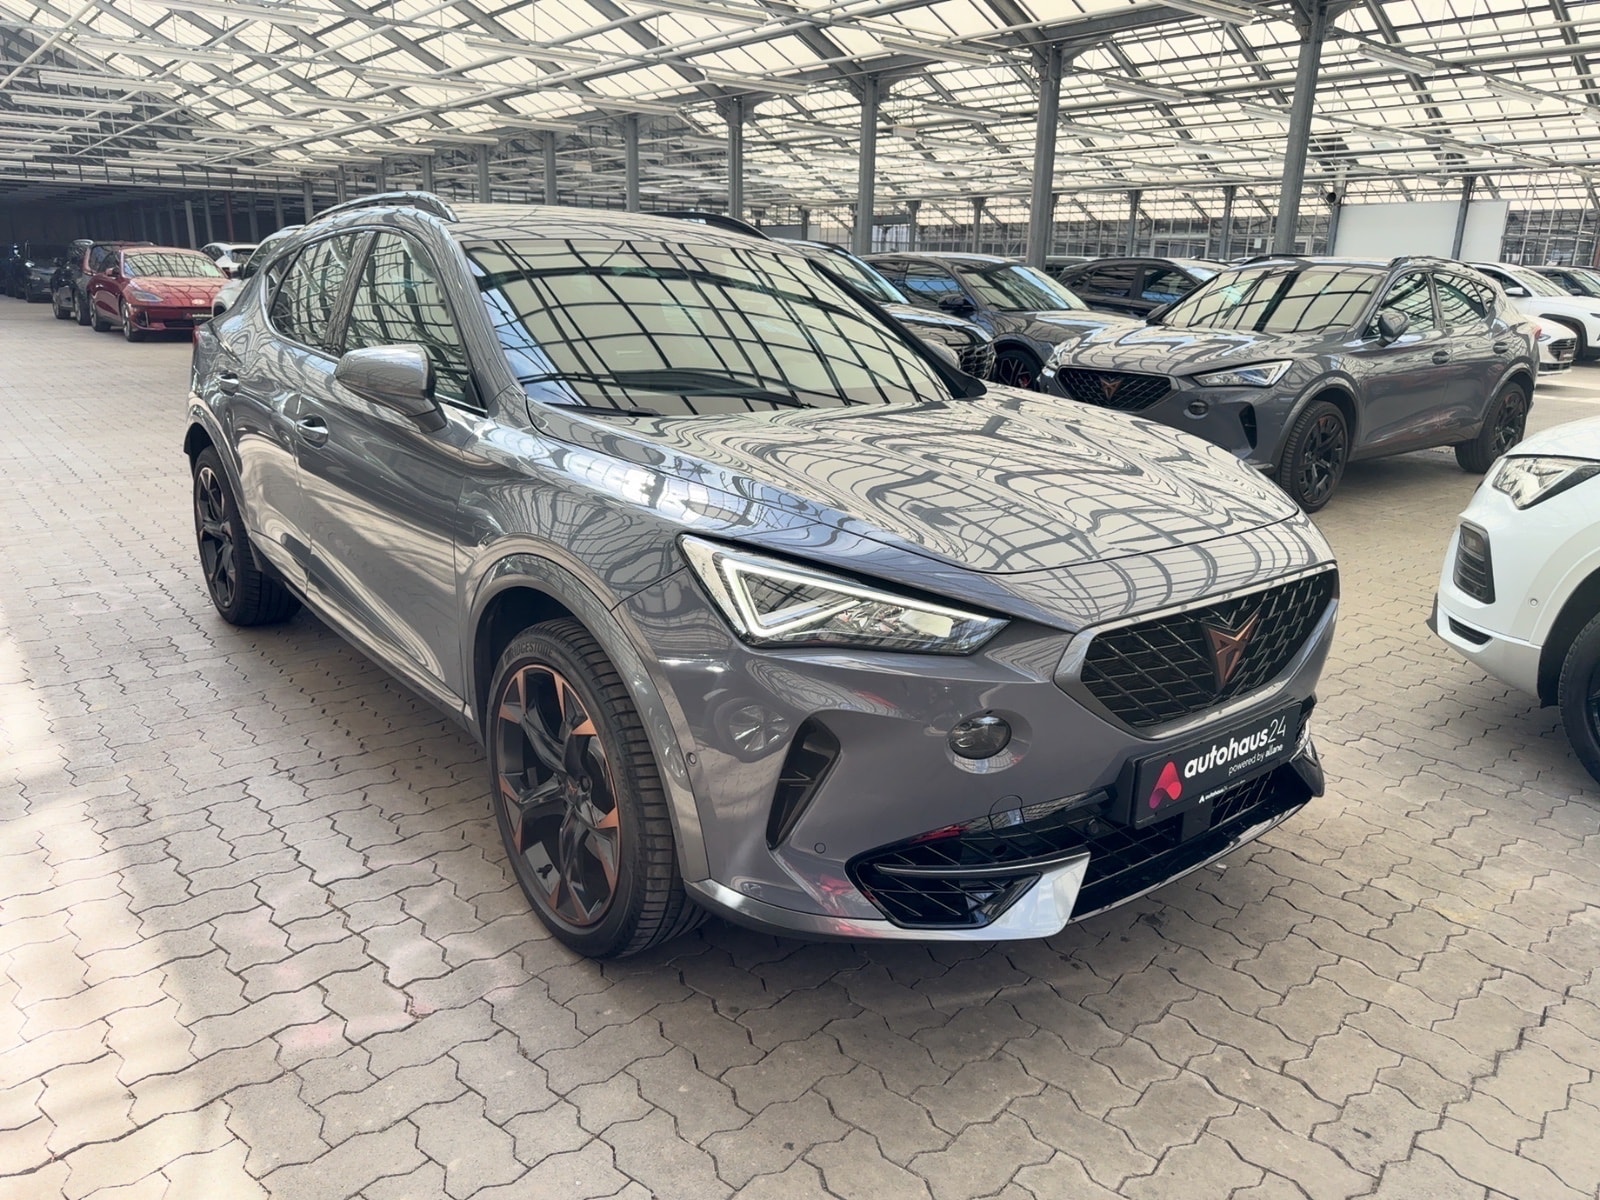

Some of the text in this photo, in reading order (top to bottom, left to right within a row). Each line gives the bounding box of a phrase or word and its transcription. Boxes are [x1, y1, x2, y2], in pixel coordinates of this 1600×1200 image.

[1184, 715, 1286, 778] autohaus24
[1228, 755, 1256, 776] powered
[1256, 752, 1265, 762] by
